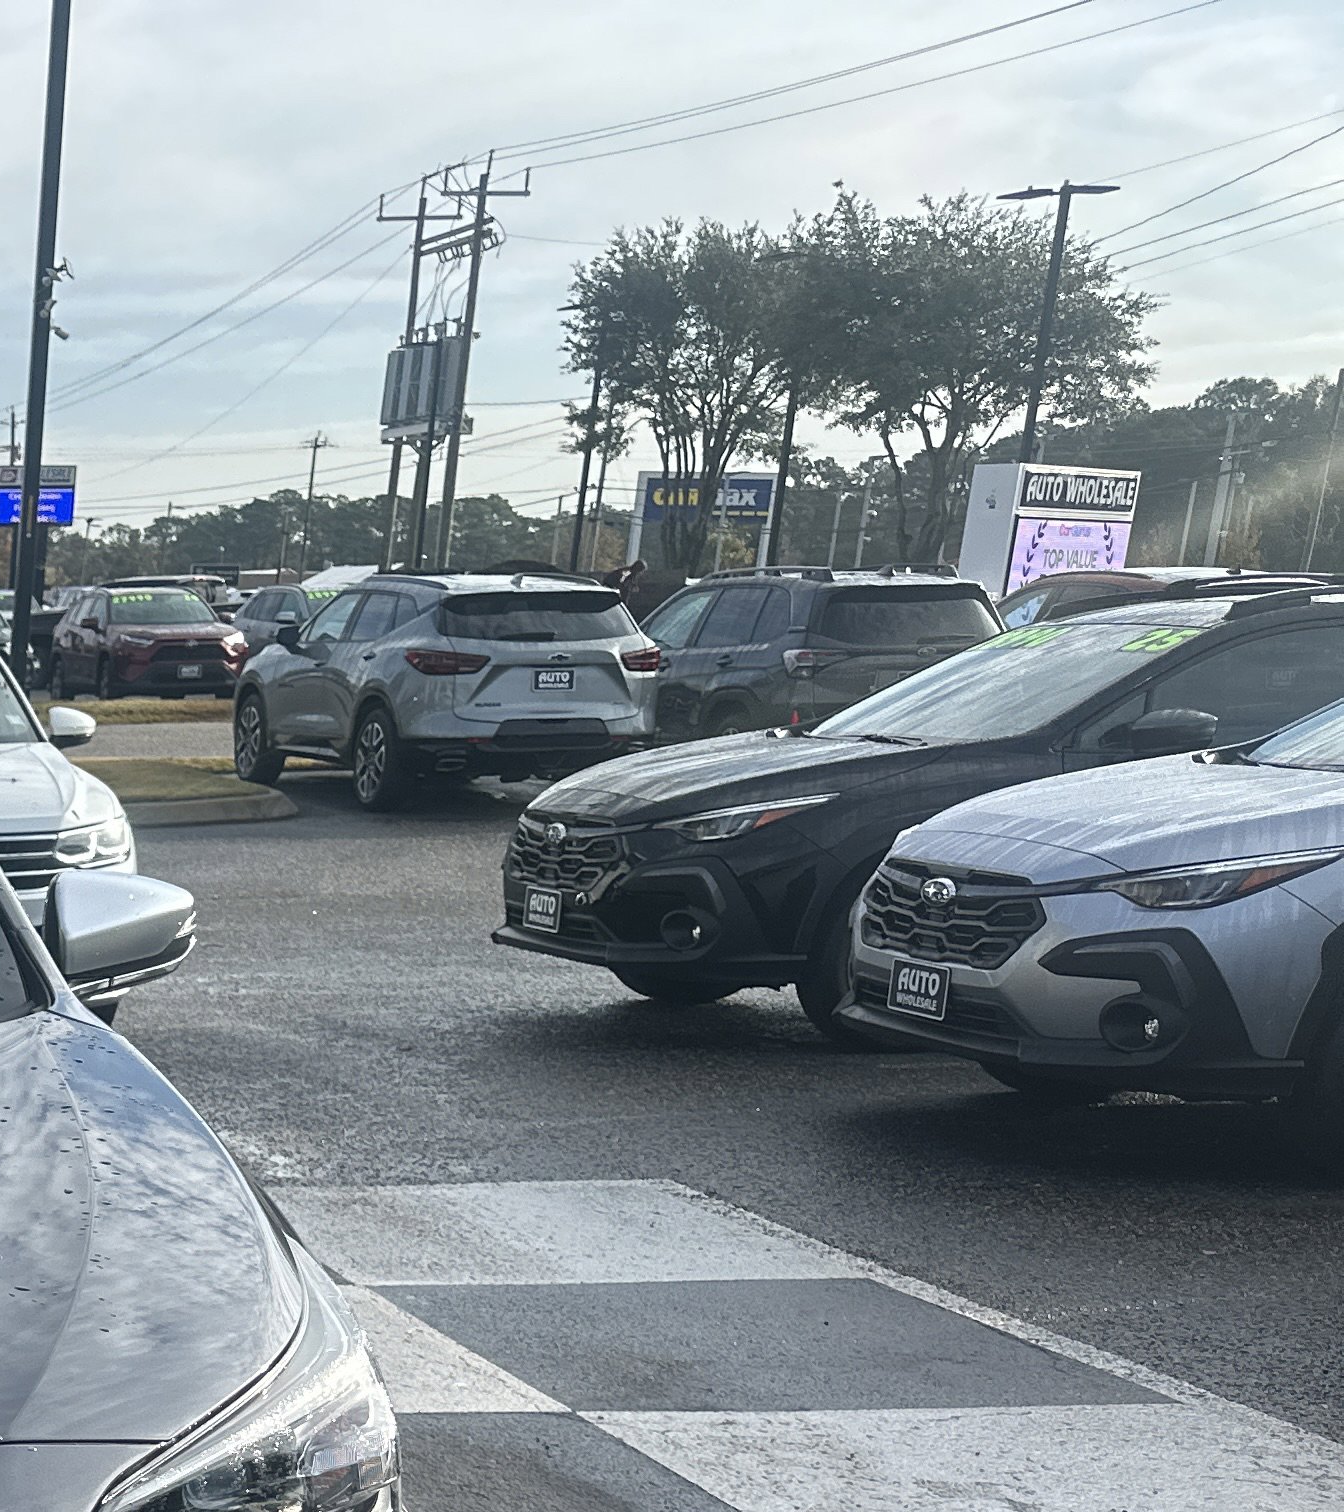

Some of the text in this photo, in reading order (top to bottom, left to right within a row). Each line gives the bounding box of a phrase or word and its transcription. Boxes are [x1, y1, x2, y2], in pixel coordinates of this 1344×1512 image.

[1026, 475, 1135, 507] AUTO WHOLESALE
[1043, 549, 1099, 569] TOP VALUE
[1119, 628, 1200, 652] 25
[538, 671, 570, 683] AUTO
[529, 893, 556, 915] AUTO
[897, 967, 941, 997] AUTO
[896, 991, 938, 1012] WHOLESALE
